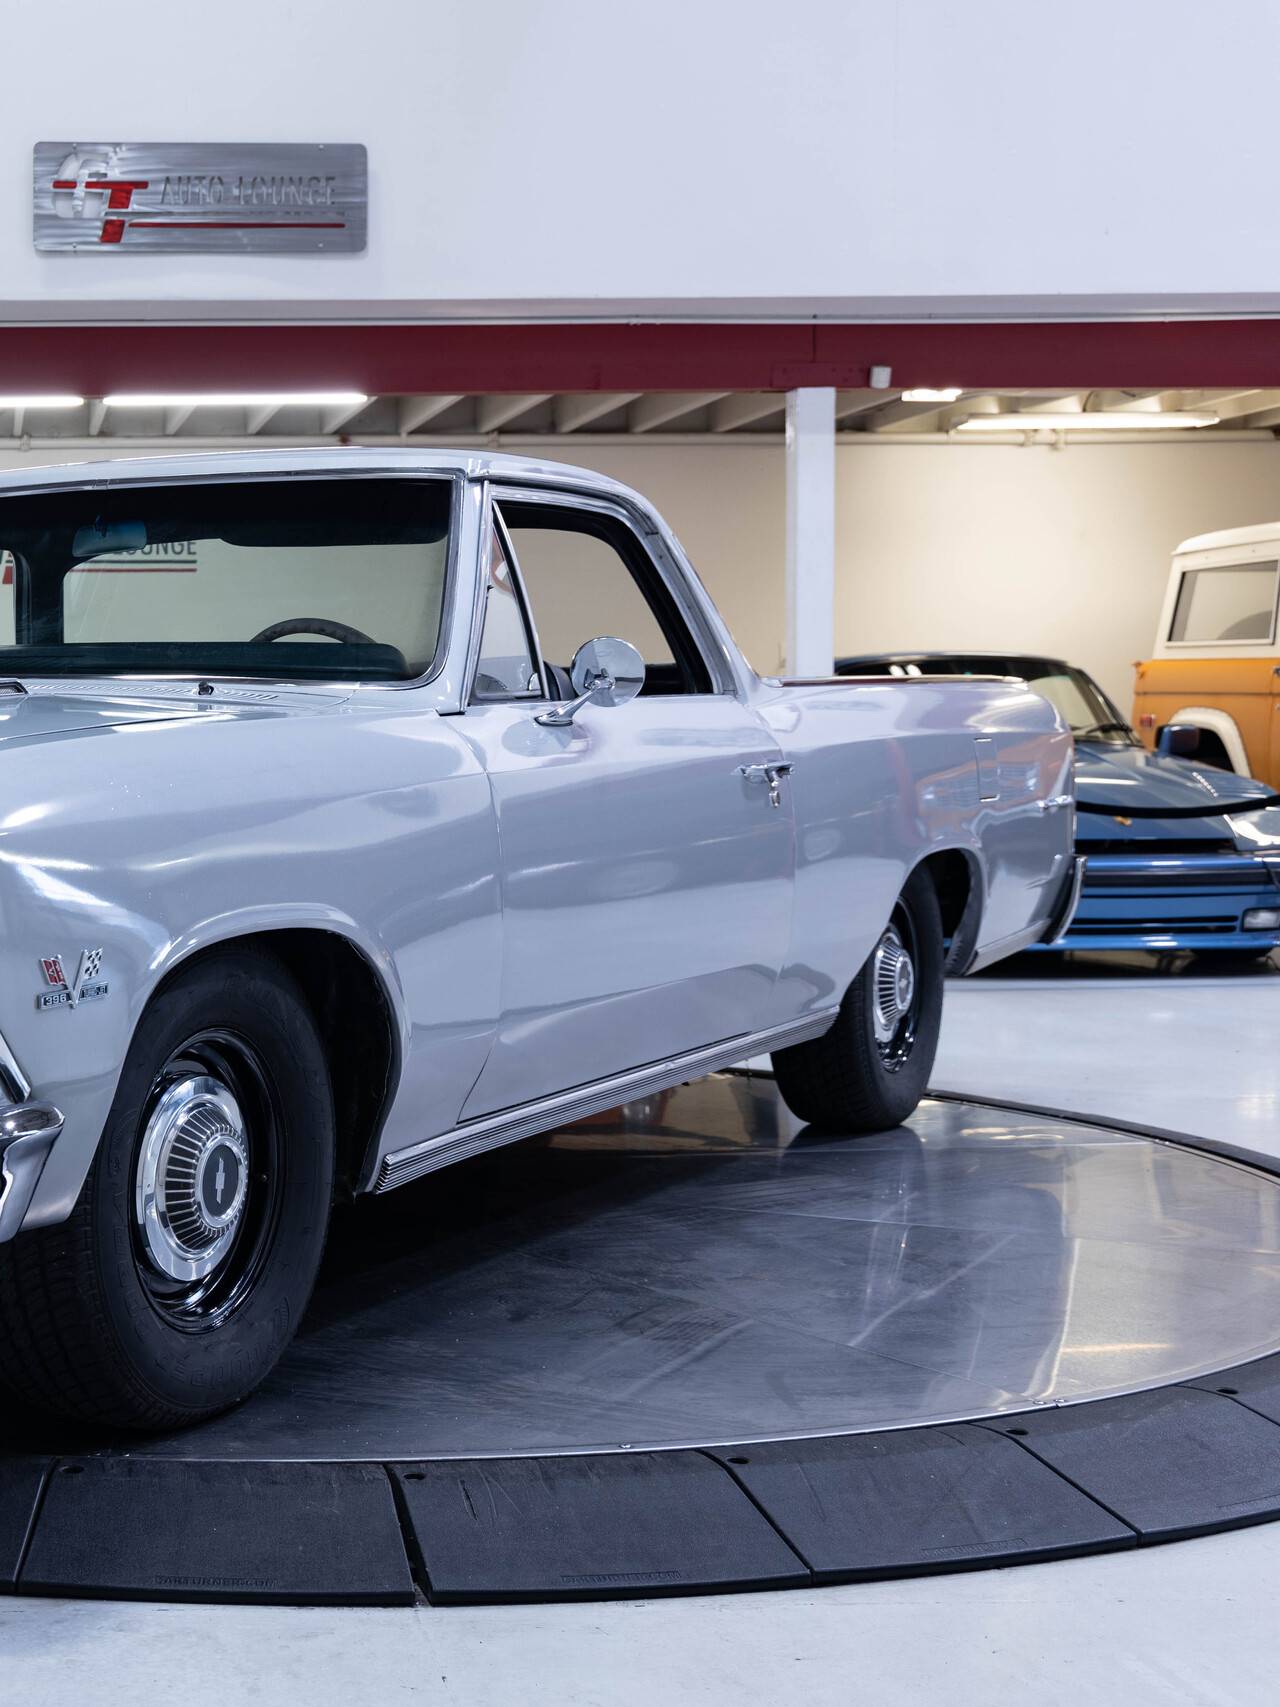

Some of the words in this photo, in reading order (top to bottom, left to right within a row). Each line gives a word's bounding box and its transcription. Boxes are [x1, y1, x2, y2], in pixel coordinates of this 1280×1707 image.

[160, 176, 224, 204] AUTO
[237, 176, 336, 205] LOUNGE
[112, 541, 197, 556] UNGE
[46, 994, 67, 1006] 396
